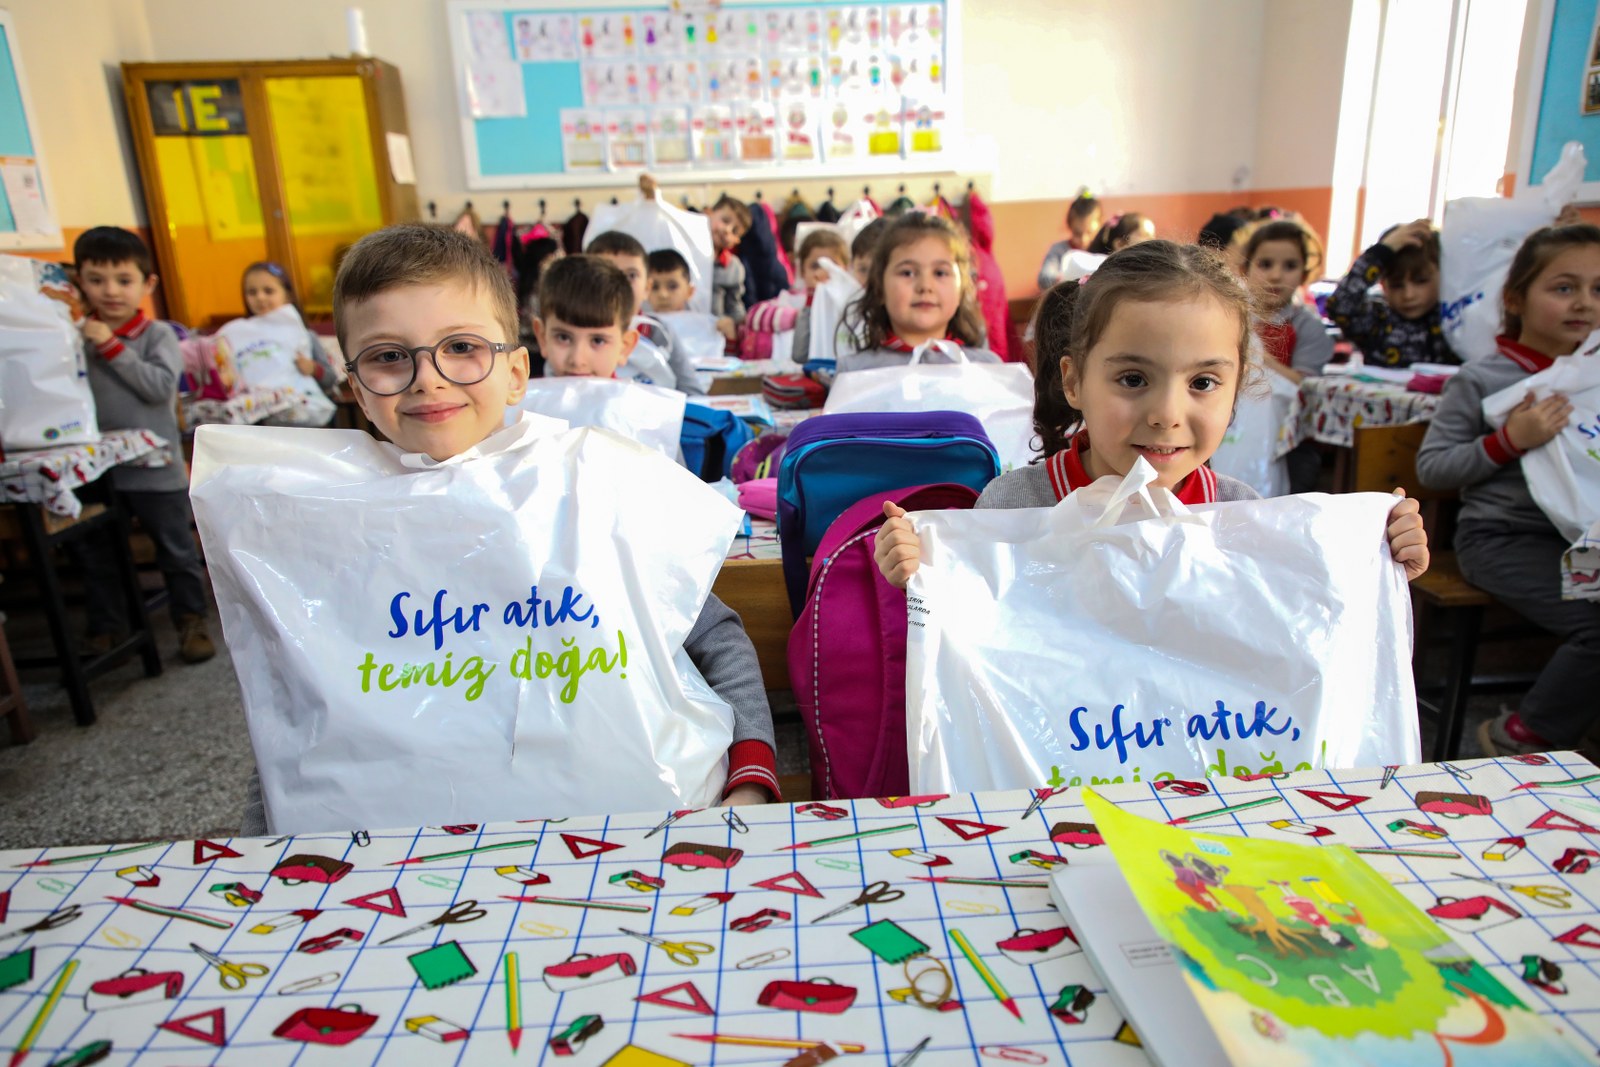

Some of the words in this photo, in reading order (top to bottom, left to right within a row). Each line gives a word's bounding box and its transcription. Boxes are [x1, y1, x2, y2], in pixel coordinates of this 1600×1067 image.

[388, 589, 491, 652] Sıfır
[502, 585, 600, 629] atık,
[357, 651, 497, 703] temiz
[509, 629, 628, 704] doğa!
[1069, 703, 1173, 764] Sıfır
[1187, 699, 1302, 742] atık,
